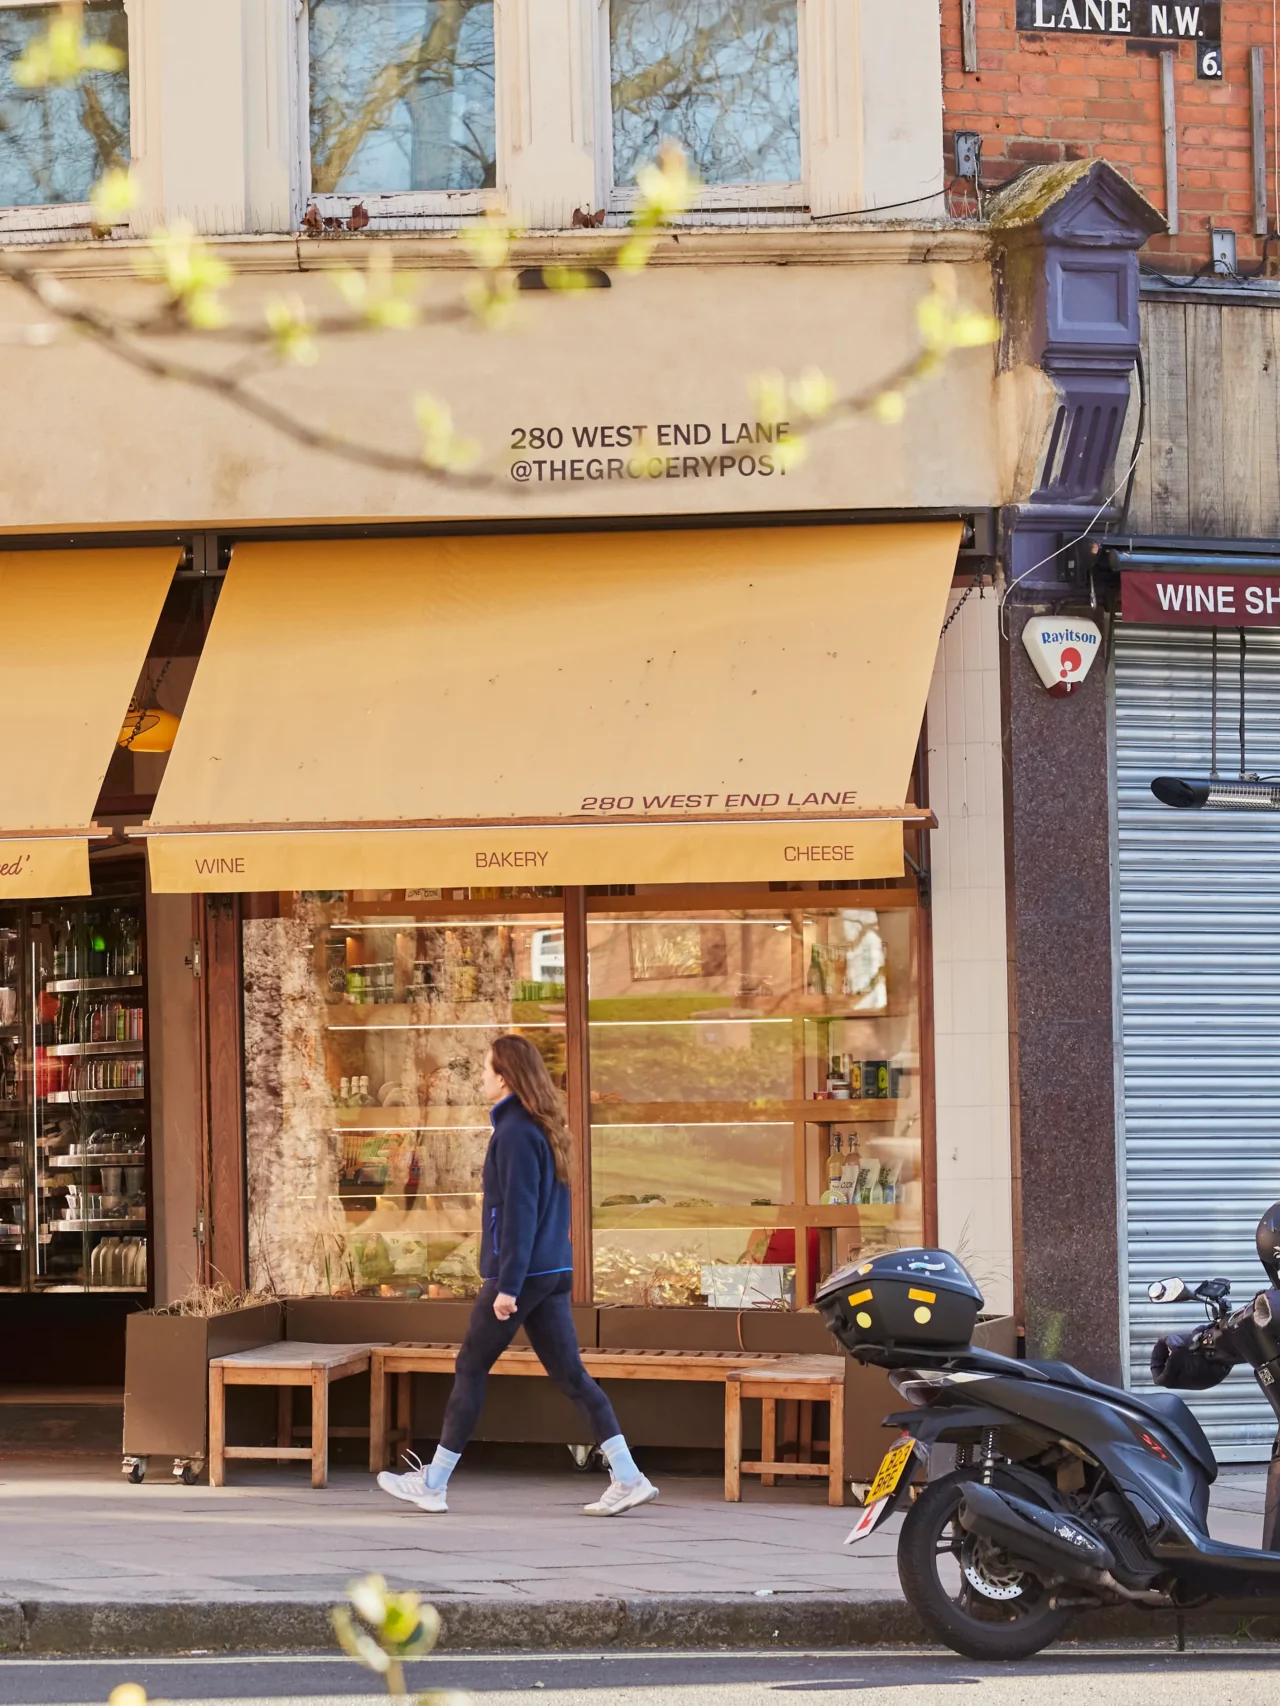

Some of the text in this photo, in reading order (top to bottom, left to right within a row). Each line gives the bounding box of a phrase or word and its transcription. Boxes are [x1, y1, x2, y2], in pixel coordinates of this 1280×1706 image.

[1033, 0, 1204, 37] LANE N.W.
[510, 421, 791, 450] 280 WEST END LANE
[1156, 583, 1236, 613] WINE
[1041, 629, 1097, 645] Rayitson
[581, 791, 857, 811] 280 WEST END LANE
[475, 851, 549, 869] BAKERY
[784, 845, 854, 862] CHEESE
[195, 858, 246, 874] WINE
